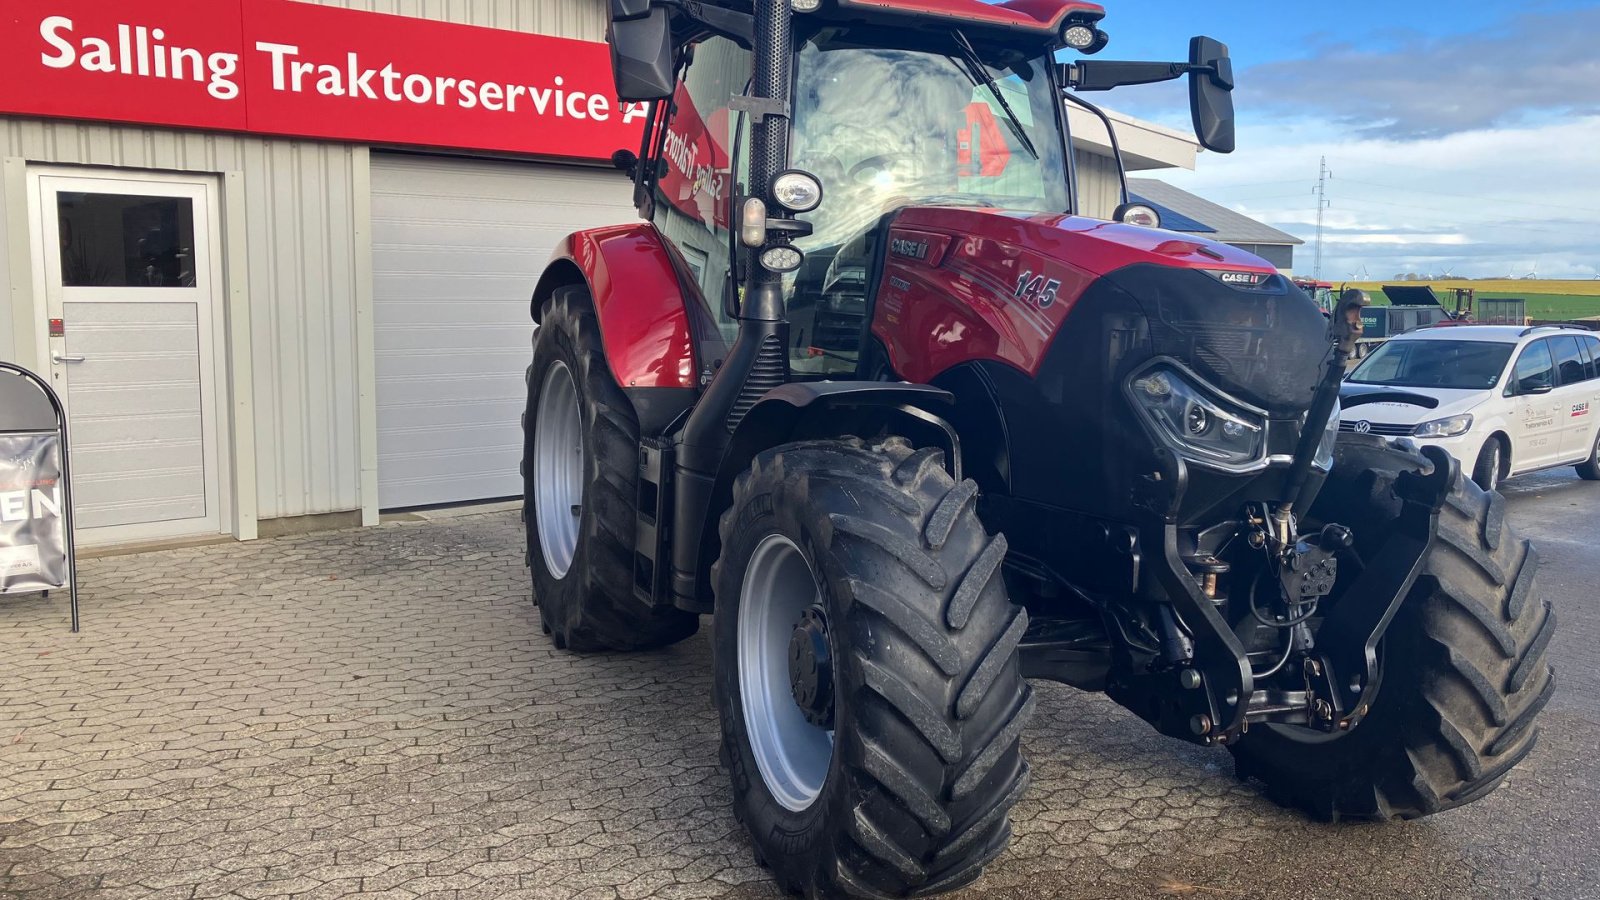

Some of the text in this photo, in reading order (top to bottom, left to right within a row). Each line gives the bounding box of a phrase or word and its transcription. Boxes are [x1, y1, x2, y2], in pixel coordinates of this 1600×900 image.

[39, 15, 240, 100] Salling
[255, 41, 610, 122] Traktorservice
[890, 238, 917, 257] CASE
[1014, 270, 1062, 310] 145
[1221, 273, 1249, 283] CASE
